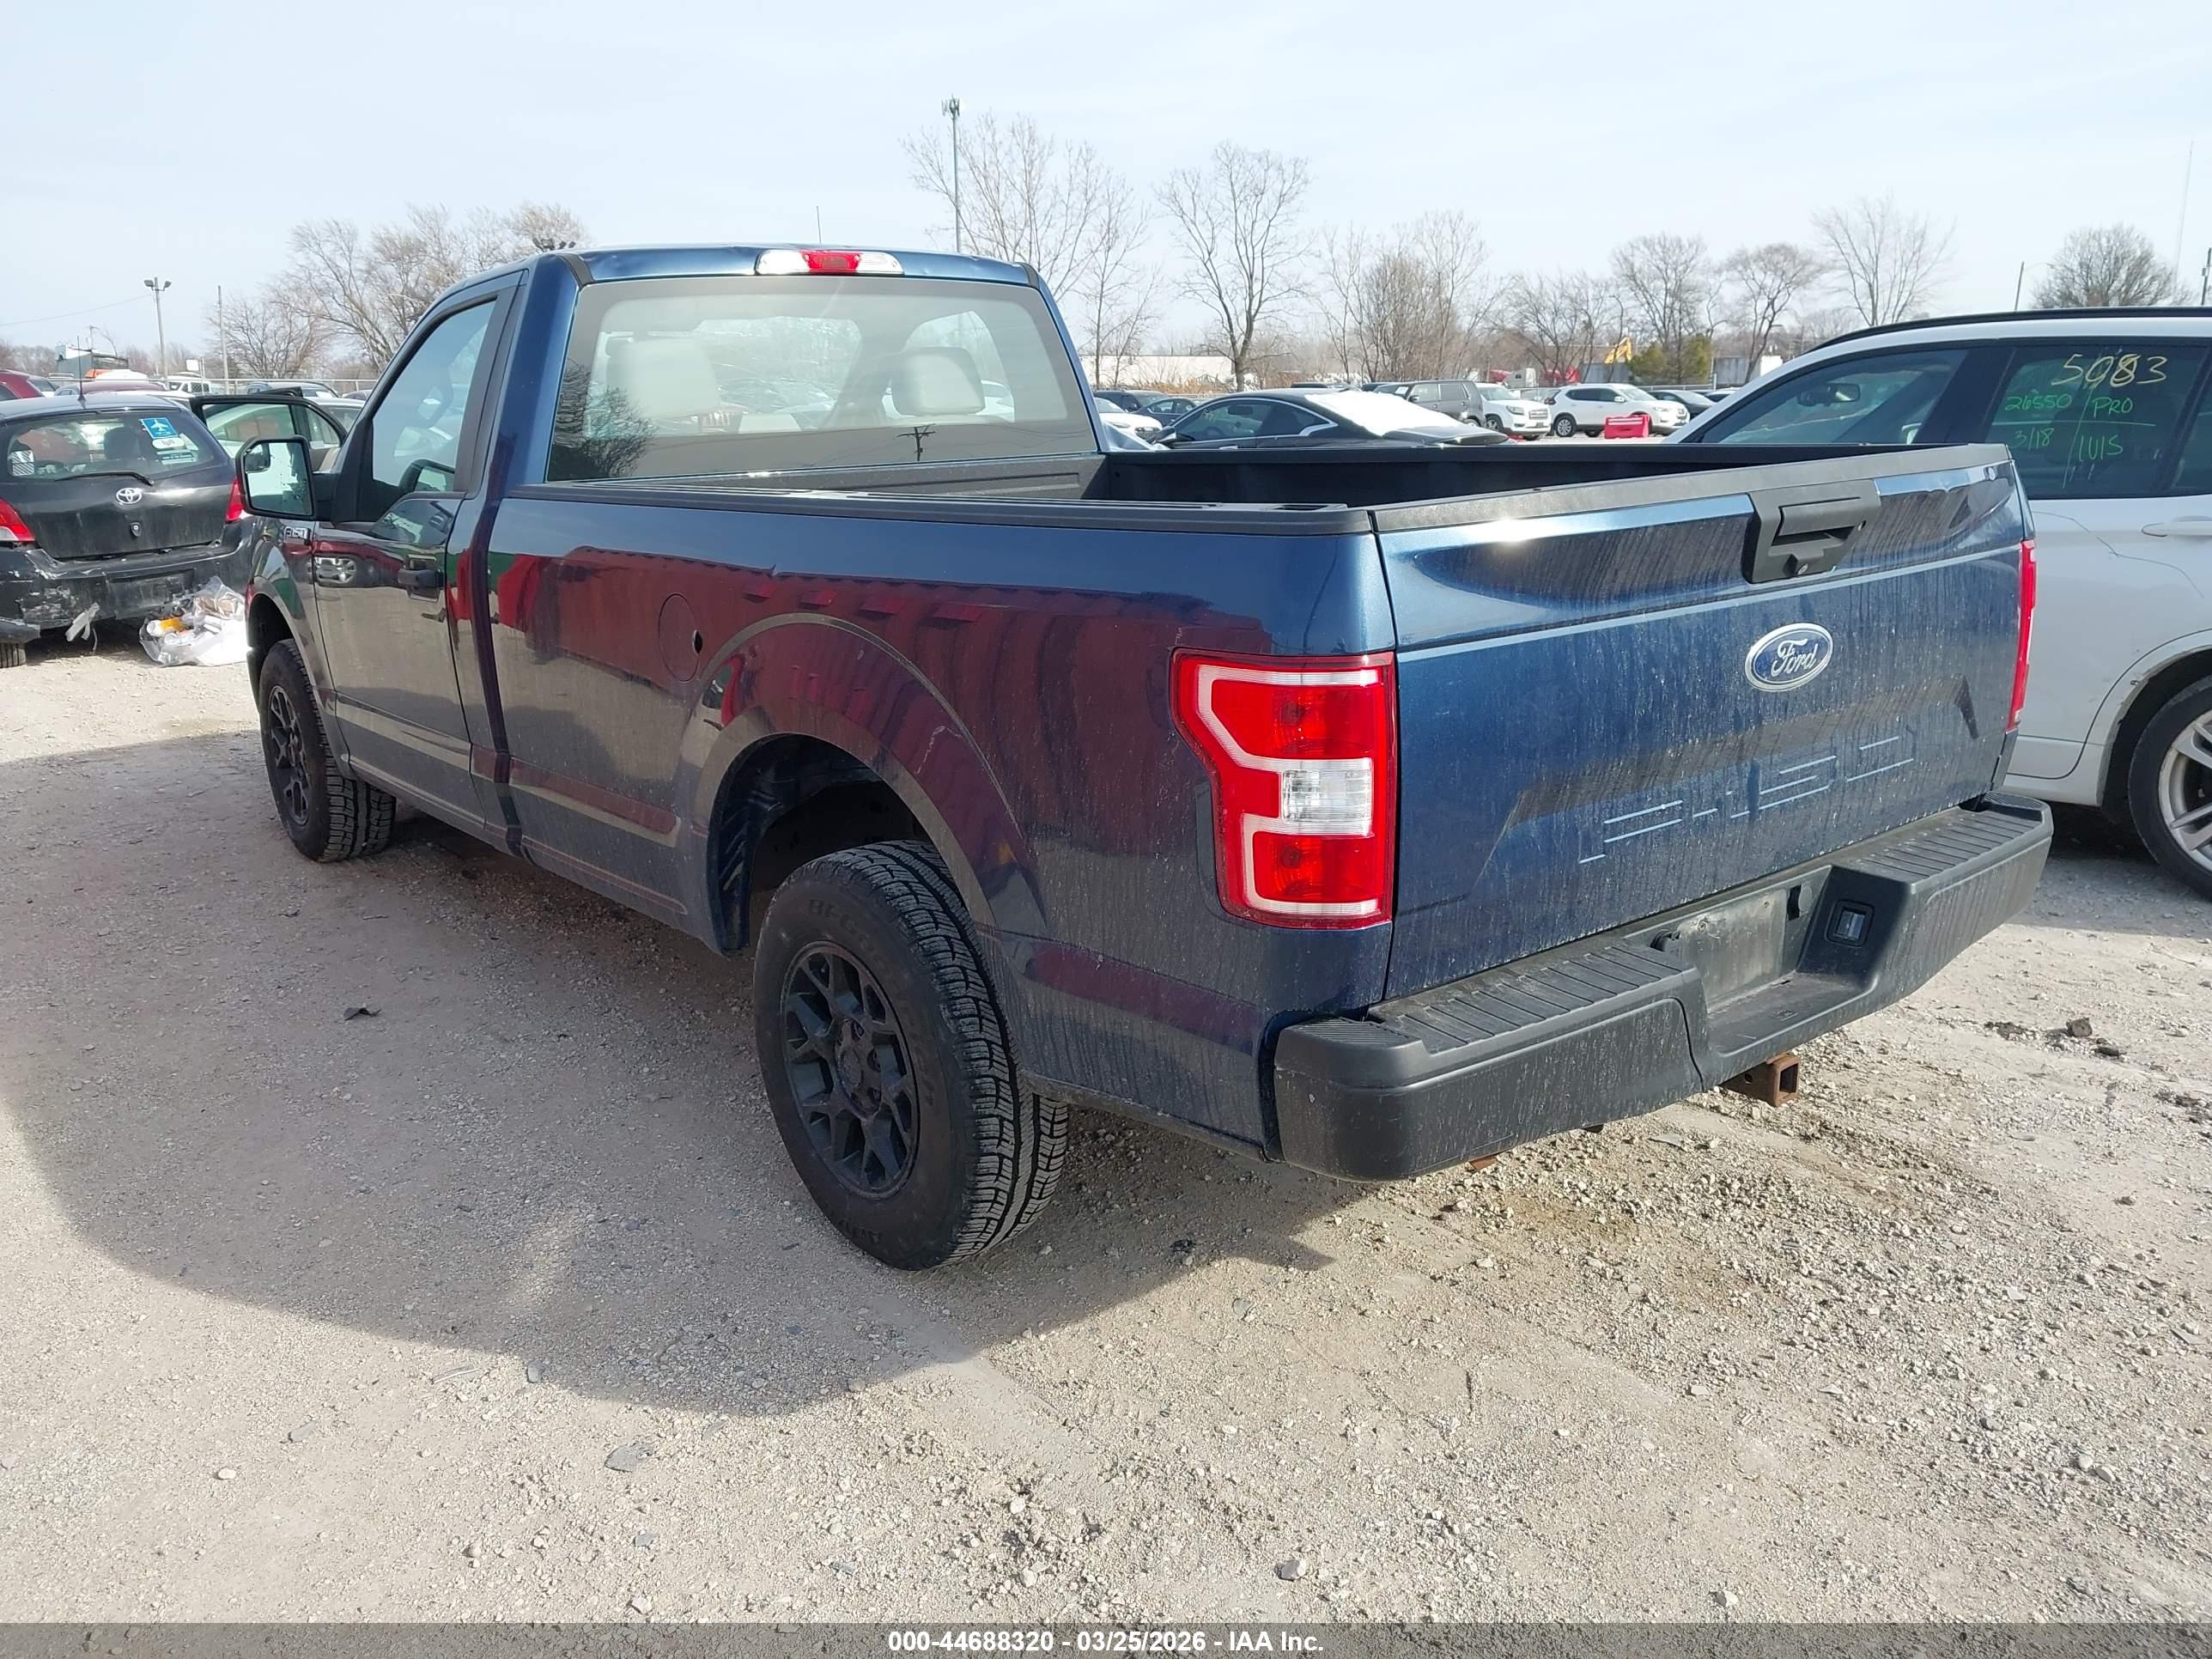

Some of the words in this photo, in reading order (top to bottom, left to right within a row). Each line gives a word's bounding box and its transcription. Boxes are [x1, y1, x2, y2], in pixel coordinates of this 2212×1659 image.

[2051, 353, 2167, 388] 5083
[2092, 397, 2134, 419] PRO
[2011, 428, 2055, 450] 3/18
[1771, 637, 1820, 678] Ford
